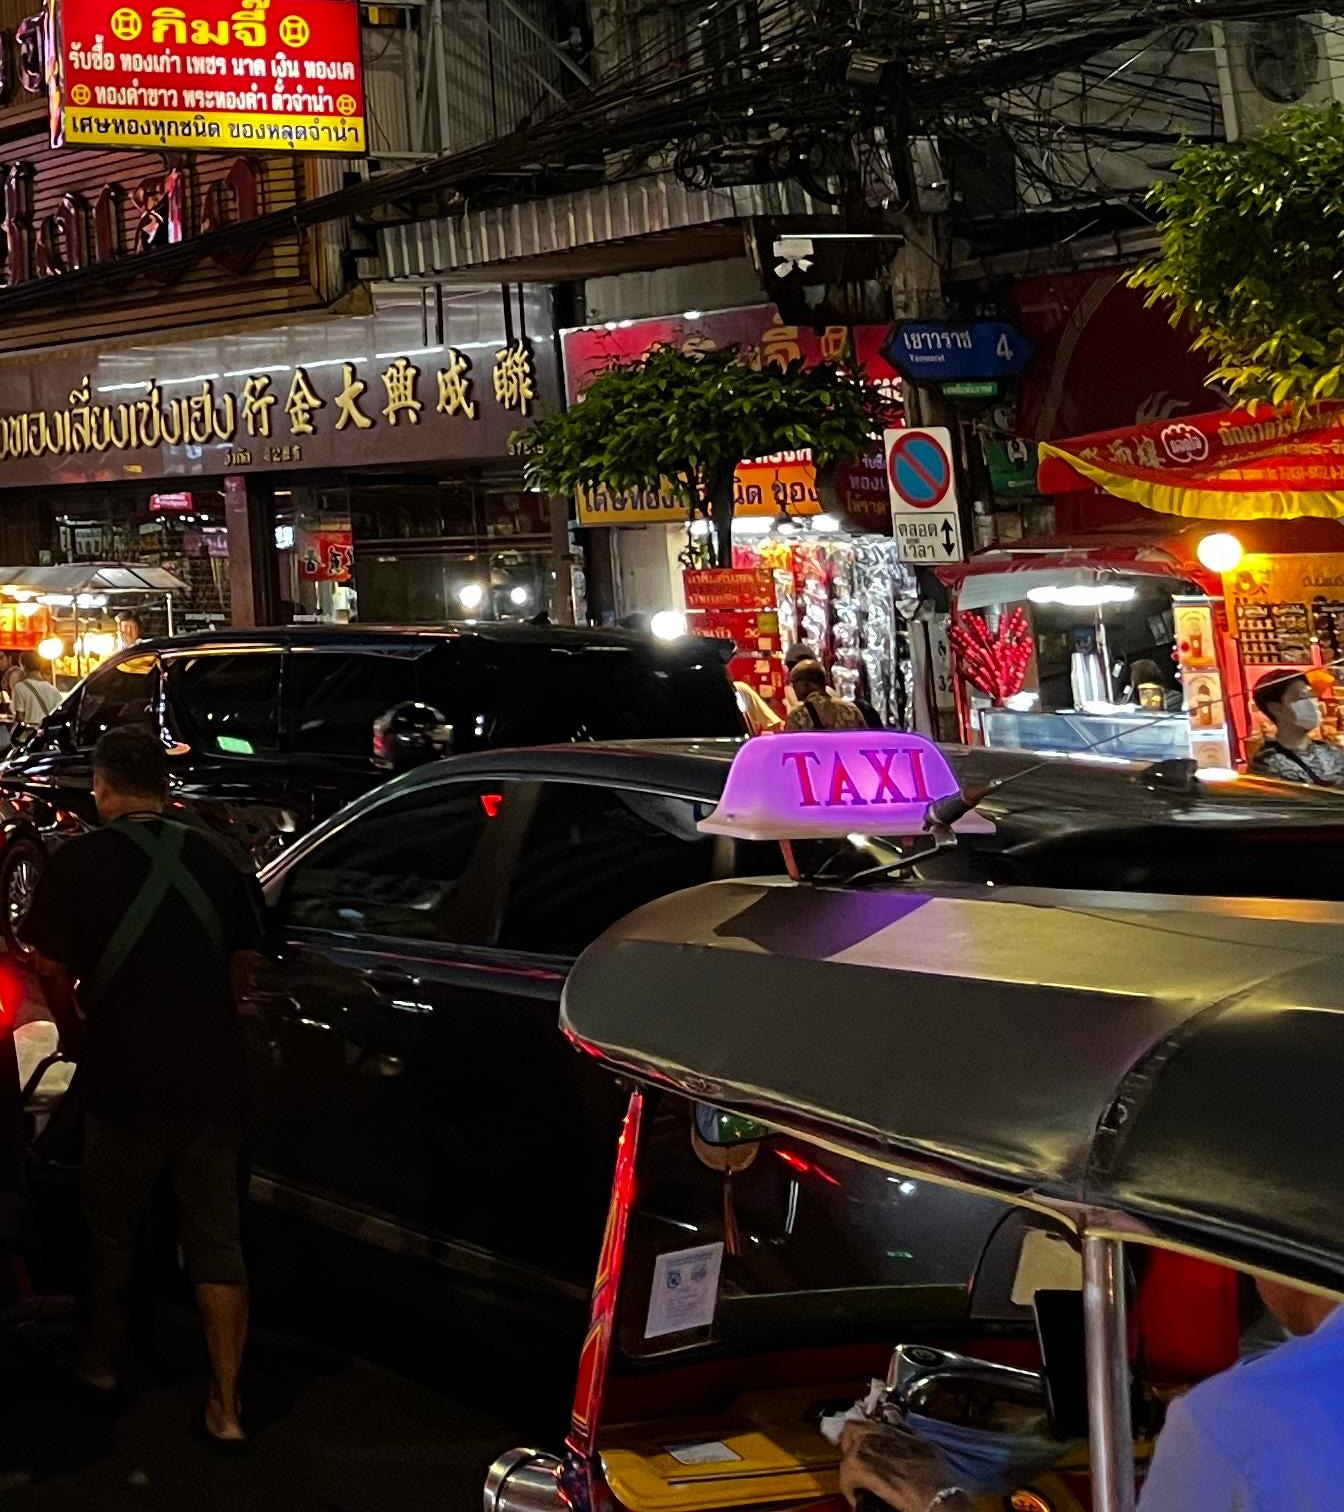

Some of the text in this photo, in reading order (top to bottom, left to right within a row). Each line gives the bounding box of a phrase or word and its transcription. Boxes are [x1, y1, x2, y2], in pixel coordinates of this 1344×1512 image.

[70, 114, 221, 144] เศษทองทุกชนิด
[903, 329, 1015, 361] เยาวราช 4
[898, 522, 938, 537] ตลอด
[902, 544, 936, 559] เวลา
[782, 748, 929, 807] TAXI
